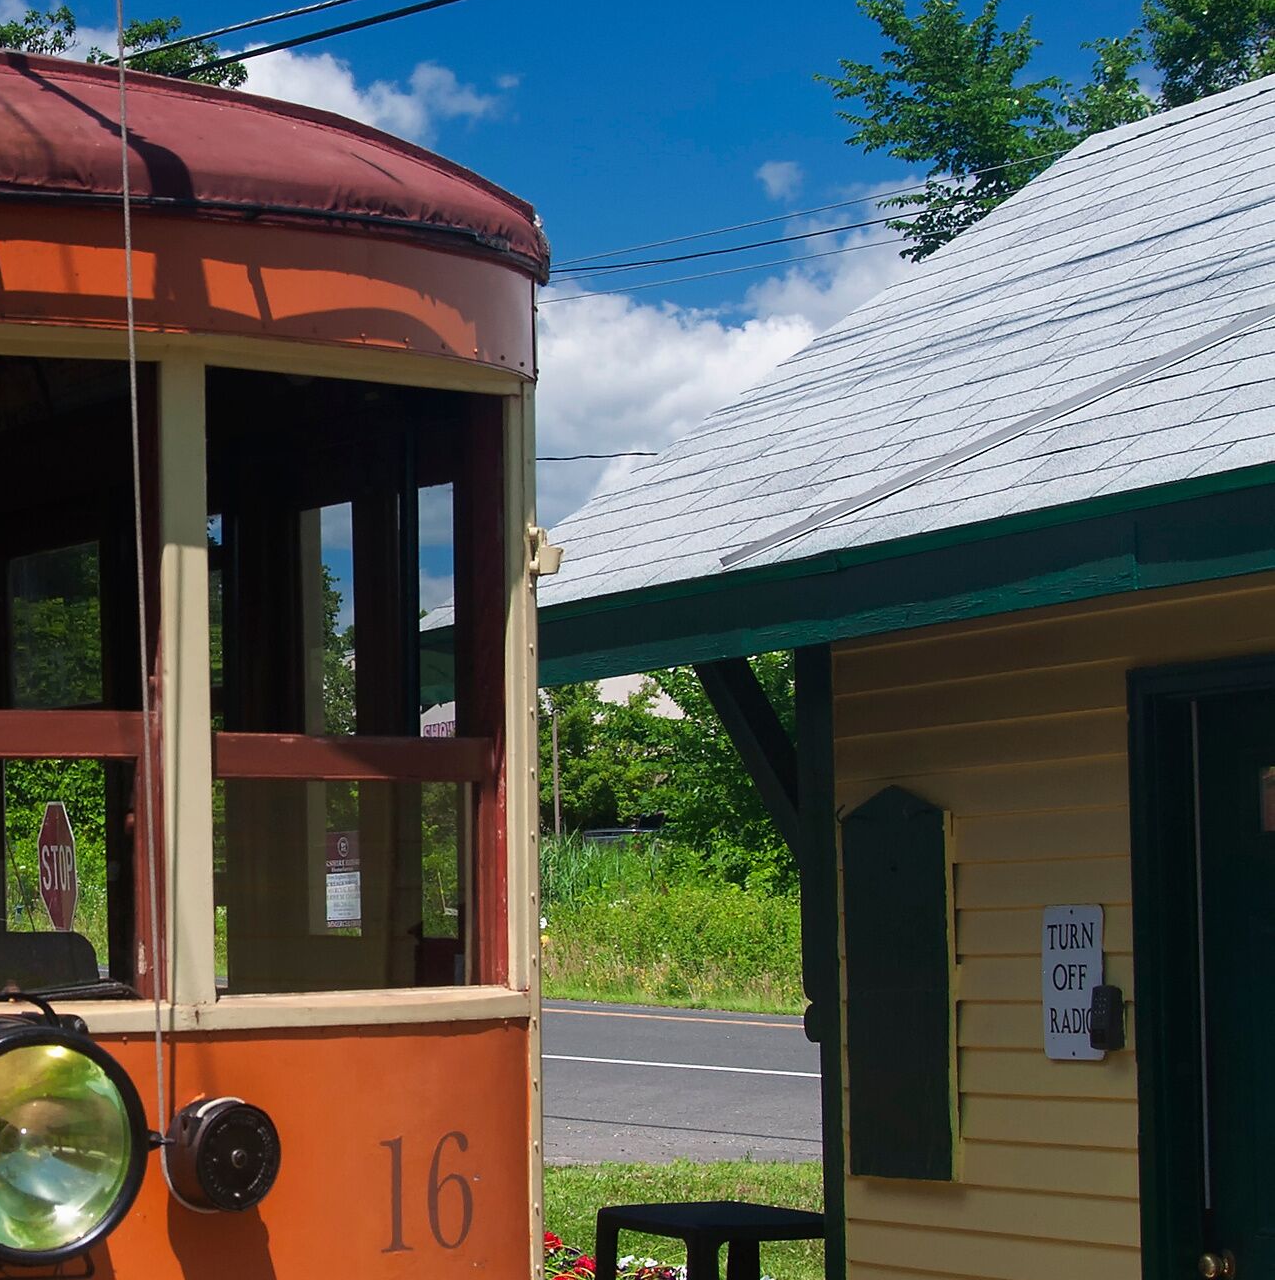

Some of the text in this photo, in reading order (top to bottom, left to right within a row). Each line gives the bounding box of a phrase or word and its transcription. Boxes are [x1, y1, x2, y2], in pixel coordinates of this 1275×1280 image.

[42, 845, 73, 891] STOP
[1047, 922, 1095, 950] TURN
[1053, 964, 1087, 991] OFF
[379, 1130, 474, 1253] 16
